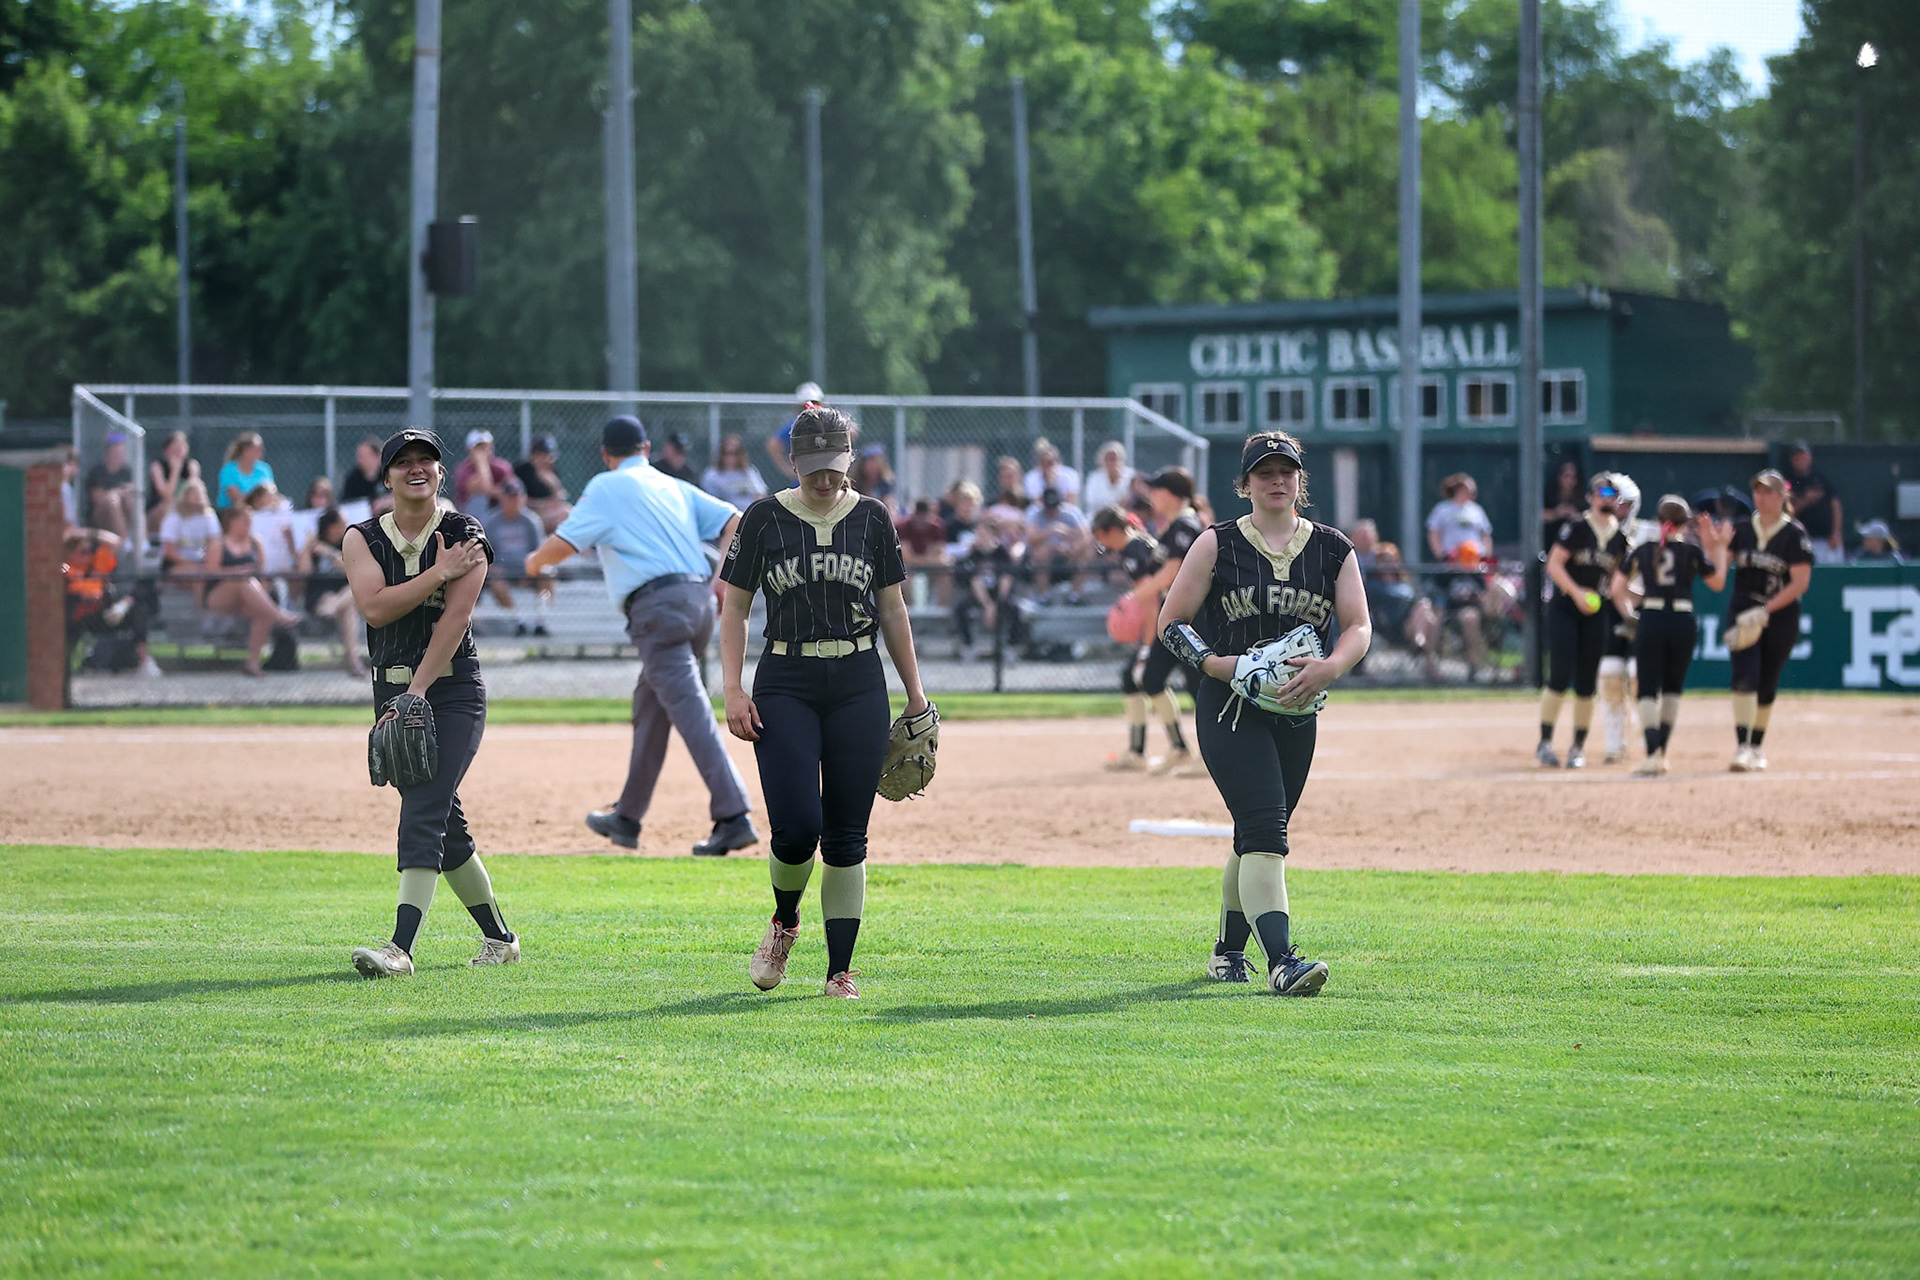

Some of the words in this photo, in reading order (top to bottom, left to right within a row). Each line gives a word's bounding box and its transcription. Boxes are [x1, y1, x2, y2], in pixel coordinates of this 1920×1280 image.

[1190, 331, 1319, 377] CELTIC
[1328, 322, 1522, 372] BASBALL
[767, 556, 807, 596] OAK
[810, 552, 874, 596] FORES
[1657, 549, 1676, 587] 2
[1221, 585, 1261, 622] OAK
